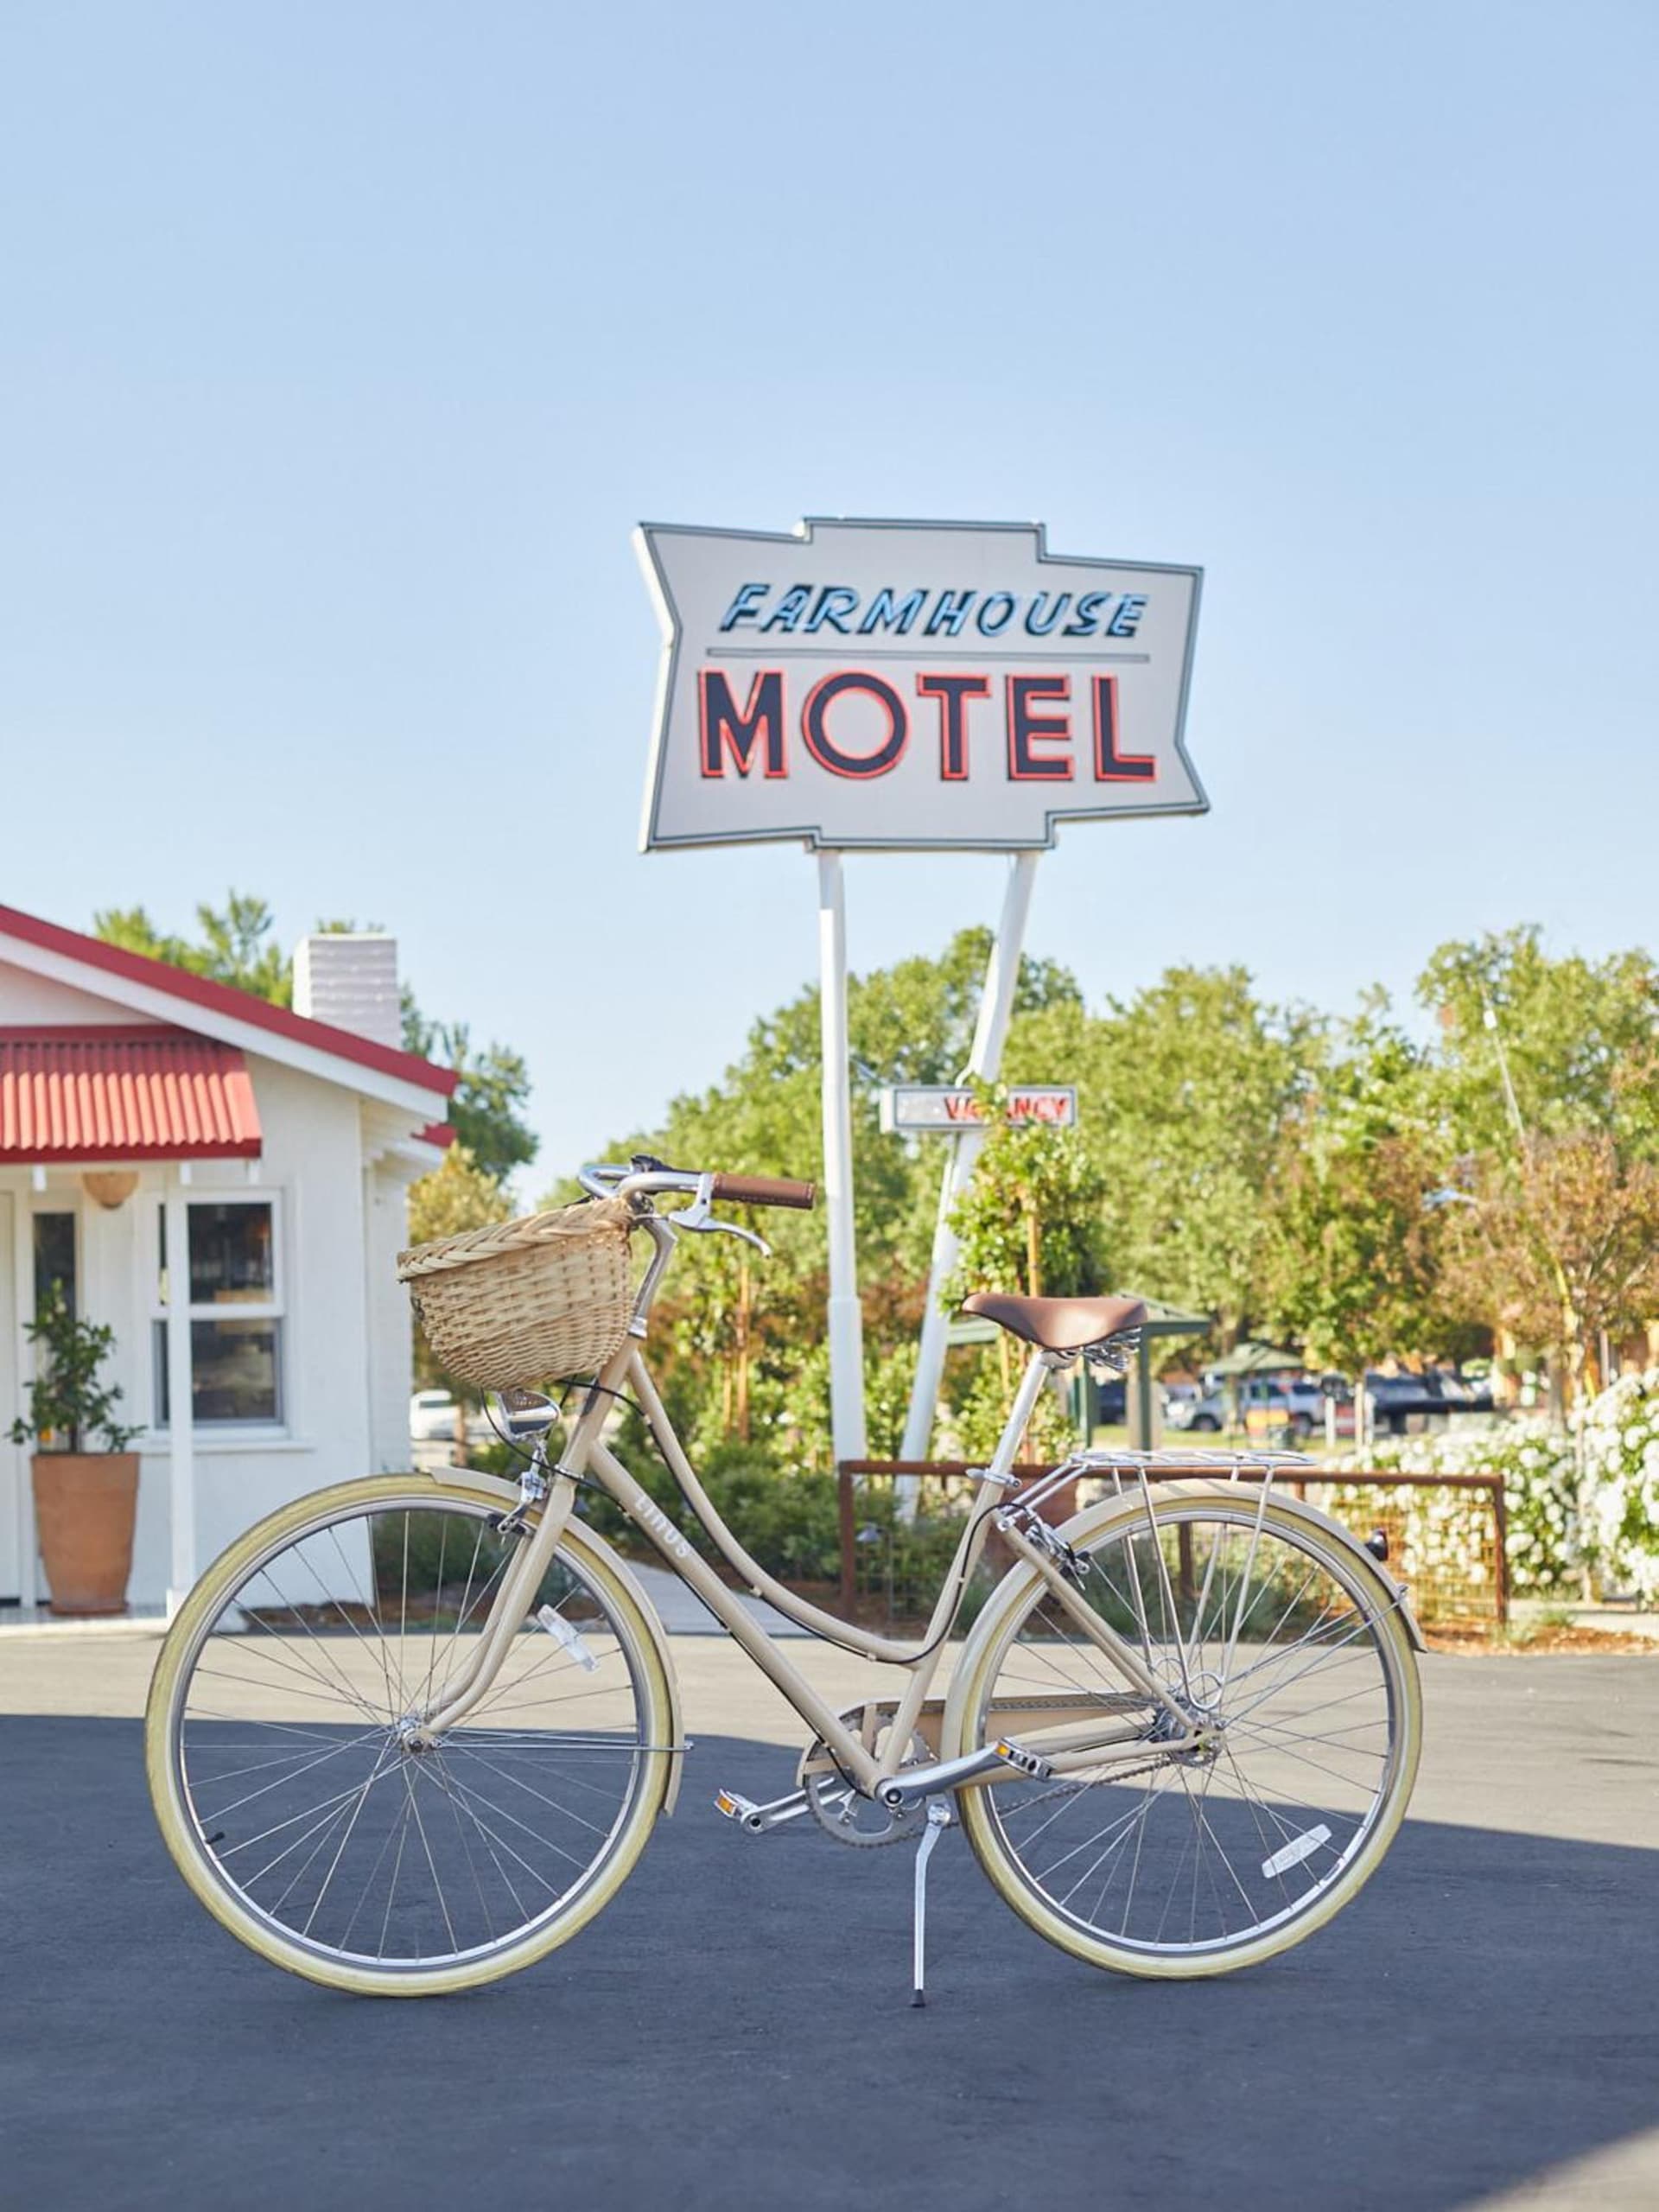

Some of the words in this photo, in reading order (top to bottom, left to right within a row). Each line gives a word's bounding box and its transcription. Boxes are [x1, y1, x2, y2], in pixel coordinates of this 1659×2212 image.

[720, 582, 1148, 638] FARMHOUSE
[698, 670, 1156, 782] MOTEL
[944, 1096, 1067, 1121] VANCY
